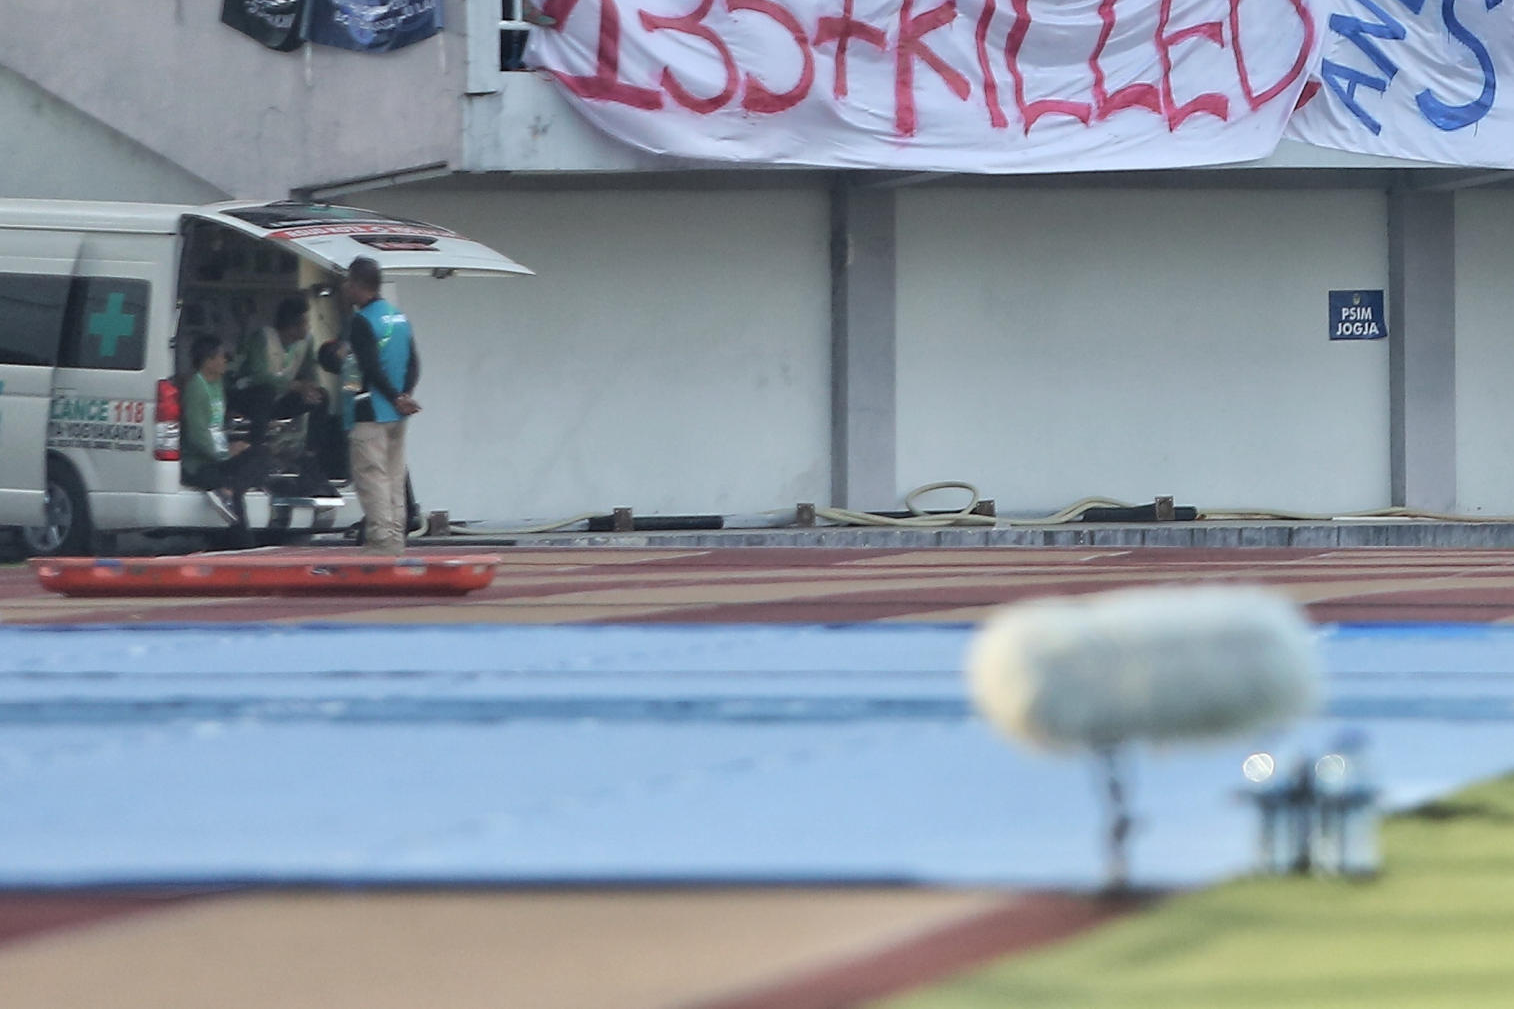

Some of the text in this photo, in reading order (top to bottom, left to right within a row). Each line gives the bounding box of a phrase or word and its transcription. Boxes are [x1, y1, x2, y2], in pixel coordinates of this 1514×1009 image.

[1341, 307, 1373, 321] PSIM
[1335, 322, 1380, 336] JOGJA
[115, 401, 145, 423] 118
